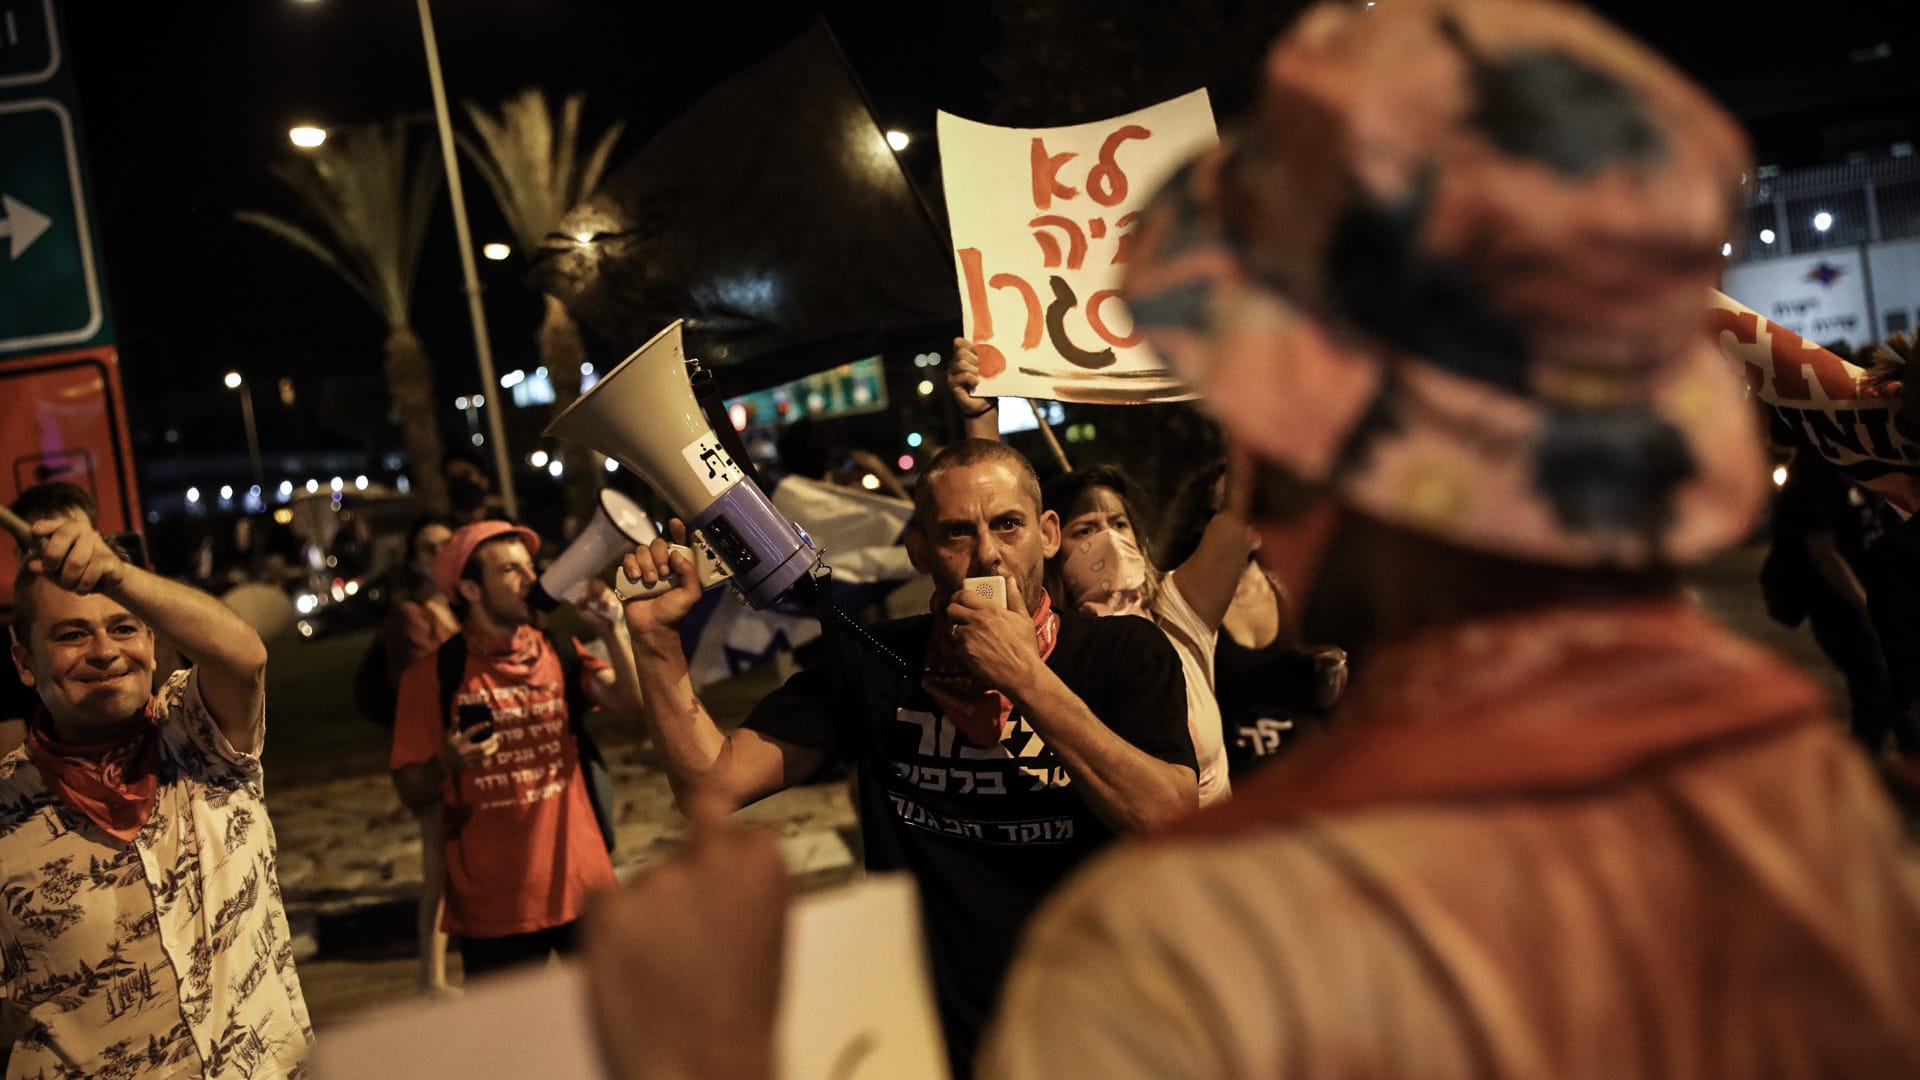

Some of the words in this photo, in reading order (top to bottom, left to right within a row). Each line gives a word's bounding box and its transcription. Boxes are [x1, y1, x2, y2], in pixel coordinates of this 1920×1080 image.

[1031, 124, 1152, 211] לא
[957, 247, 1146, 379] סגר!
[998, 817, 1075, 843] מוקד
